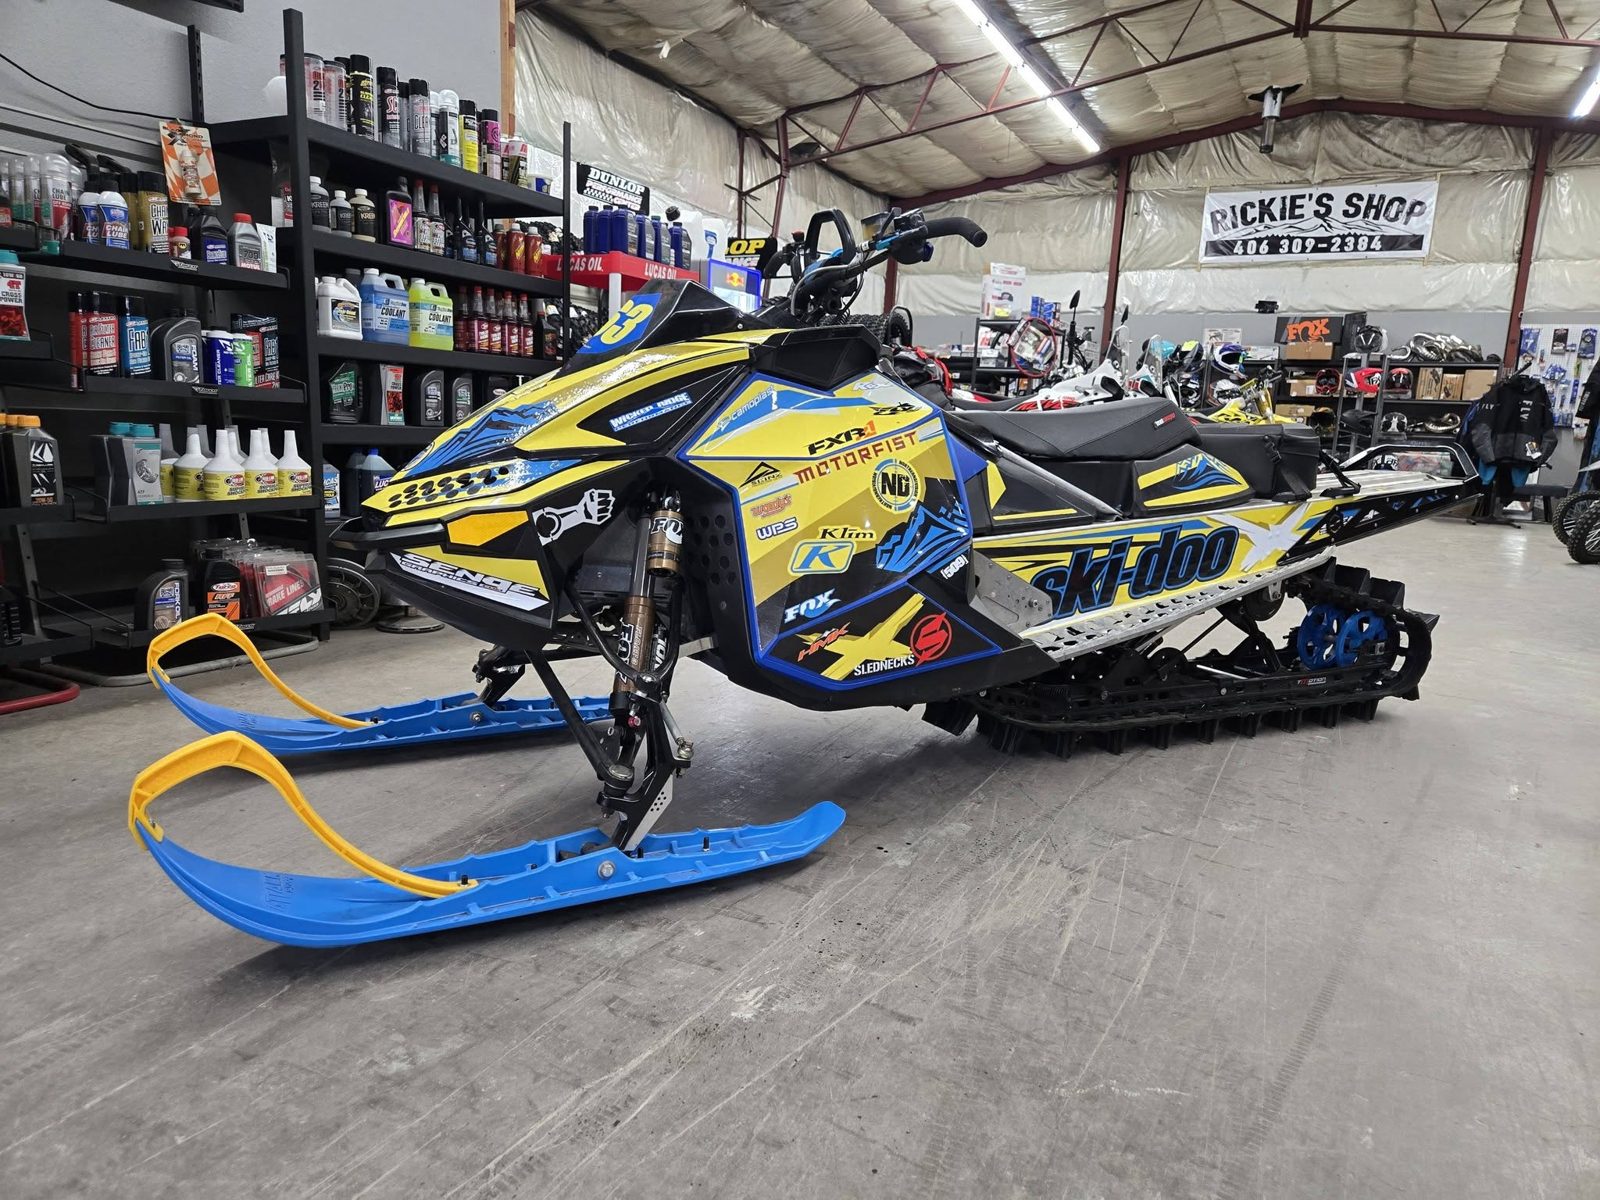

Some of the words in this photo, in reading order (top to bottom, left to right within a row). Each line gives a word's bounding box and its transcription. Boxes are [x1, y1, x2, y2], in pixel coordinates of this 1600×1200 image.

[585, 179, 643, 205] PERFORMANCE
[588, 167, 645, 195] DUNLOP
[1209, 192, 1335, 235] RICKIE'S
[1342, 192, 1428, 226] SHOP
[106, 230, 128, 239] LUBE
[1233, 239, 1270, 255] 406
[1278, 234, 1383, 254] 309-2384
[557, 257, 585, 272] LCAS
[644, 262, 667, 279] LUCAS
[381, 307, 407, 319] COOLANT
[428, 312, 452, 324] COOLANT
[1286, 318, 1330, 342] FOX
[191, 344, 199, 371] FOAM
[808, 427, 866, 455] FXR
[793, 430, 918, 485] MOTORFIST
[756, 517, 799, 540] WPS
[820, 528, 876, 540] Klim
[1031, 523, 1240, 619] ski-doo
[784, 588, 841, 624] FOX
[654, 636, 669, 671] VOL
[853, 654, 916, 677] SLEDNECKS
